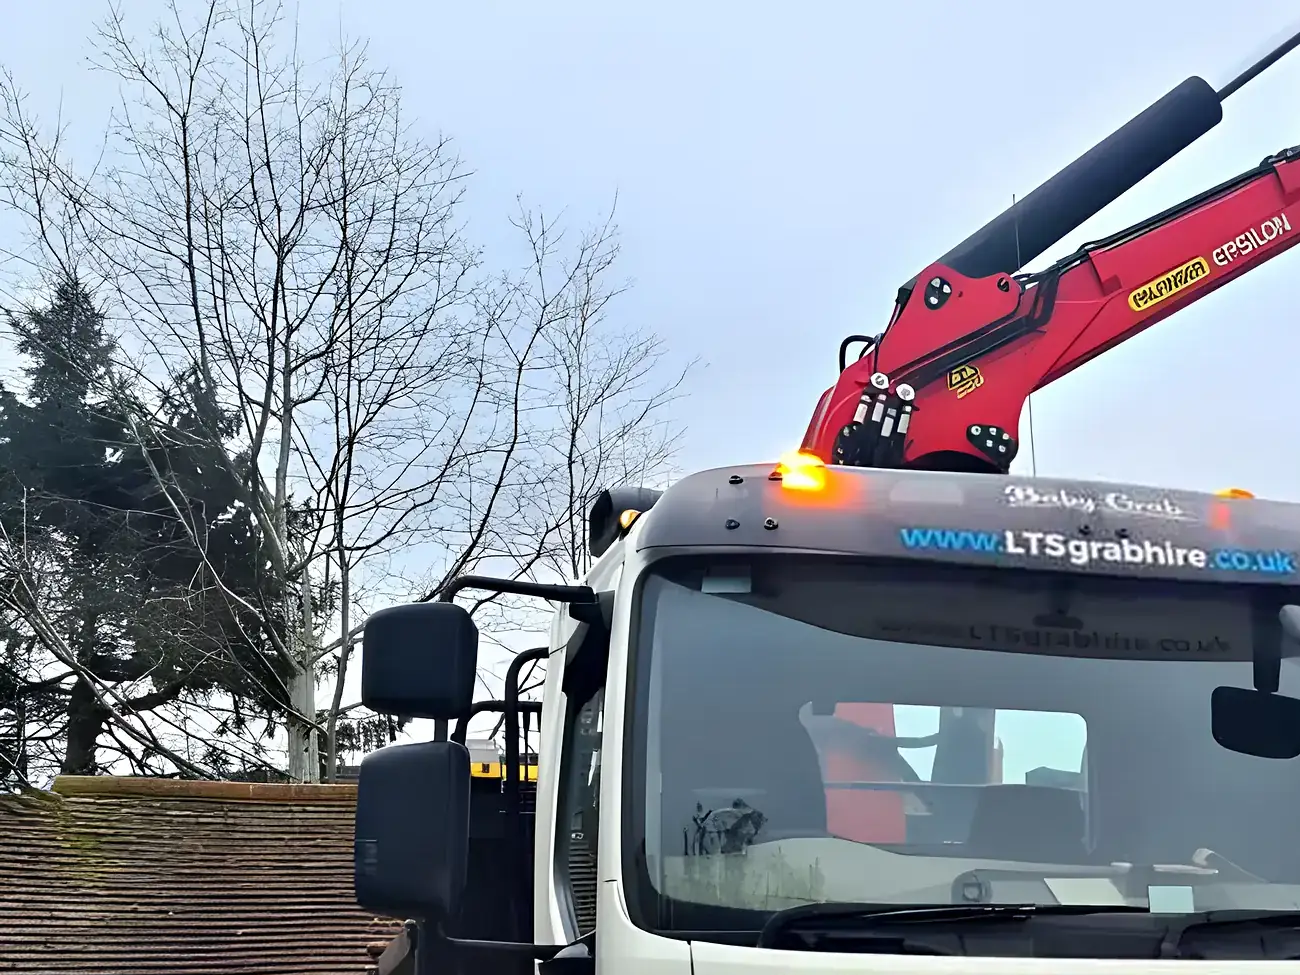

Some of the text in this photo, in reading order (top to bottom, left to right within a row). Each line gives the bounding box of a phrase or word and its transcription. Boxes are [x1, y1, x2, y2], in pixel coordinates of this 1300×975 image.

[1212, 212, 1292, 266] EPSILON
[1004, 485, 1183, 515] Baby Grab
[900, 527, 1297, 574] www.LTSgrabhire.co.uk
